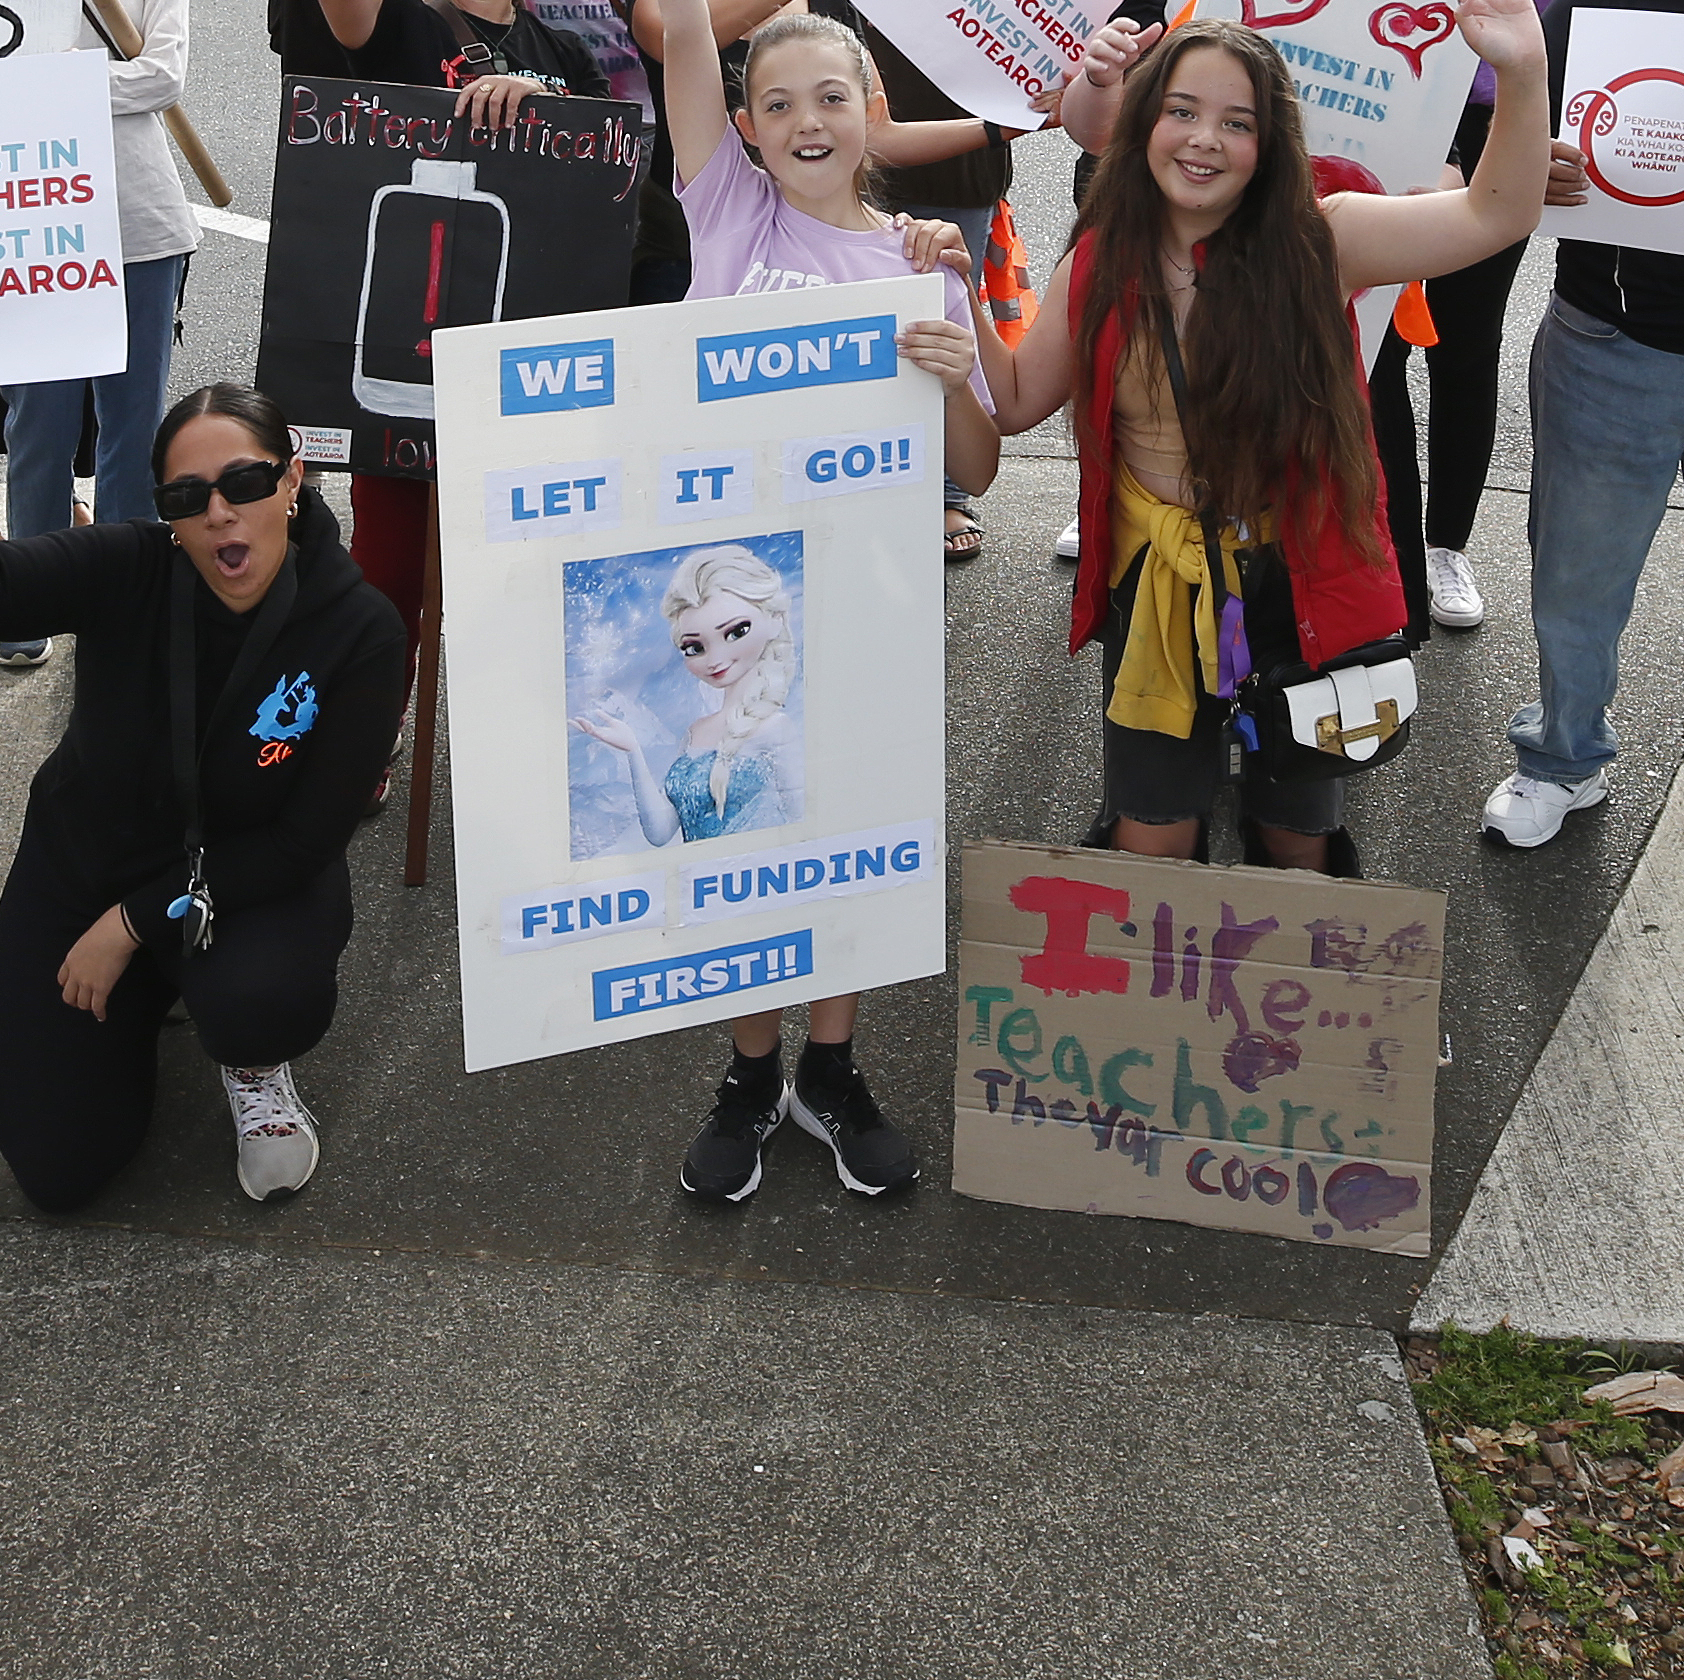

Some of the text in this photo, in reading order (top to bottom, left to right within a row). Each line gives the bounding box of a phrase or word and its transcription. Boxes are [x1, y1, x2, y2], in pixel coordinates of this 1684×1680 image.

[1069, 12, 1094, 40] IN
[946, 7, 1043, 97] AOTEARO
[1033, 54, 1061, 82] IN
[1364, 67, 1395, 91] IN
[287, 85, 453, 158] Battery
[1630, 128, 1645, 138] TE
[38, 137, 79, 170] IN
[1615, 148, 1627, 158] KI
[1628, 149, 1637, 159] A
[1618, 137, 1635, 148] KIA
[1637, 139, 1666, 151] WHAI
[43, 223, 85, 256] IN
[516, 330, 881, 399] WE WON'T
[510, 438, 912, 522] LET IT GO!!
[521, 841, 921, 940] FIND FUNDING
[1009, 876, 1130, 997] I
[609, 944, 798, 1014] FIRST!!
